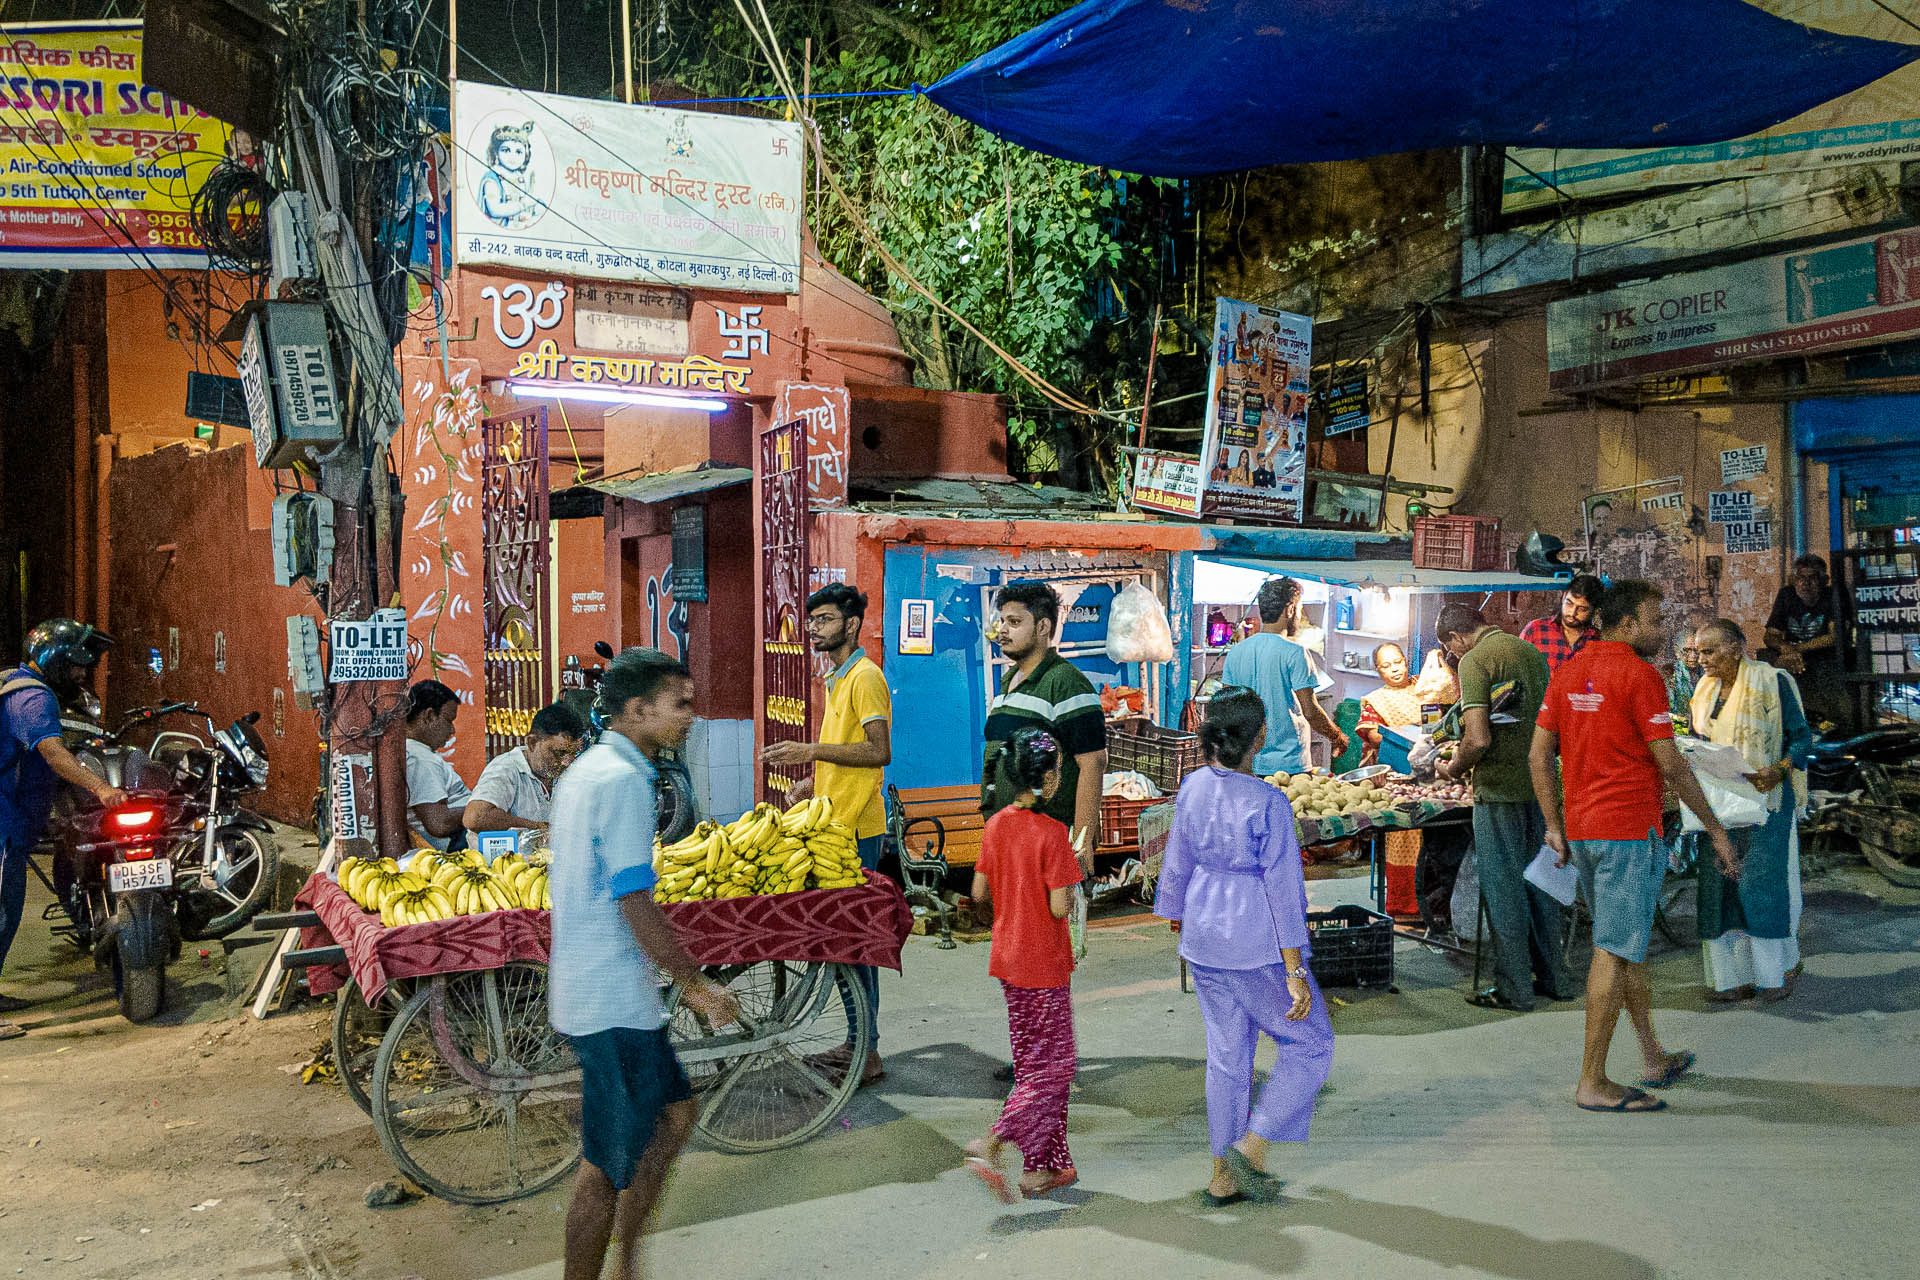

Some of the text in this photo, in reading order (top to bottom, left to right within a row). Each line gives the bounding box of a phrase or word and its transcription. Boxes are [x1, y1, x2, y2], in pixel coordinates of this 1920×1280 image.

[0, 40, 135, 70] ासिक फीस
[136, 163, 187, 178] School
[11, 184, 37, 198] 5th
[96, 186, 147, 201] Center
[648, 168, 707, 202] मन्दिर
[10, 210, 49, 224] Mother
[52, 211, 84, 227] Dairy,
[513, 245, 542, 258] नानक
[1596, 290, 1728, 332] JK COPIER
[1611, 333, 1653, 350] Express
[1656, 331, 1667, 342] to
[1714, 321, 1873, 357] SHRI SAI STATIONERY
[508, 340, 566, 381] श्री
[659, 354, 751, 393] मन्दिर
[1722, 446, 1764, 461] TO-LET
[1711, 492, 1752, 506] TO-LET
[1725, 521, 1770, 537] TO-LET
[335, 627, 404, 648] TO-LET
